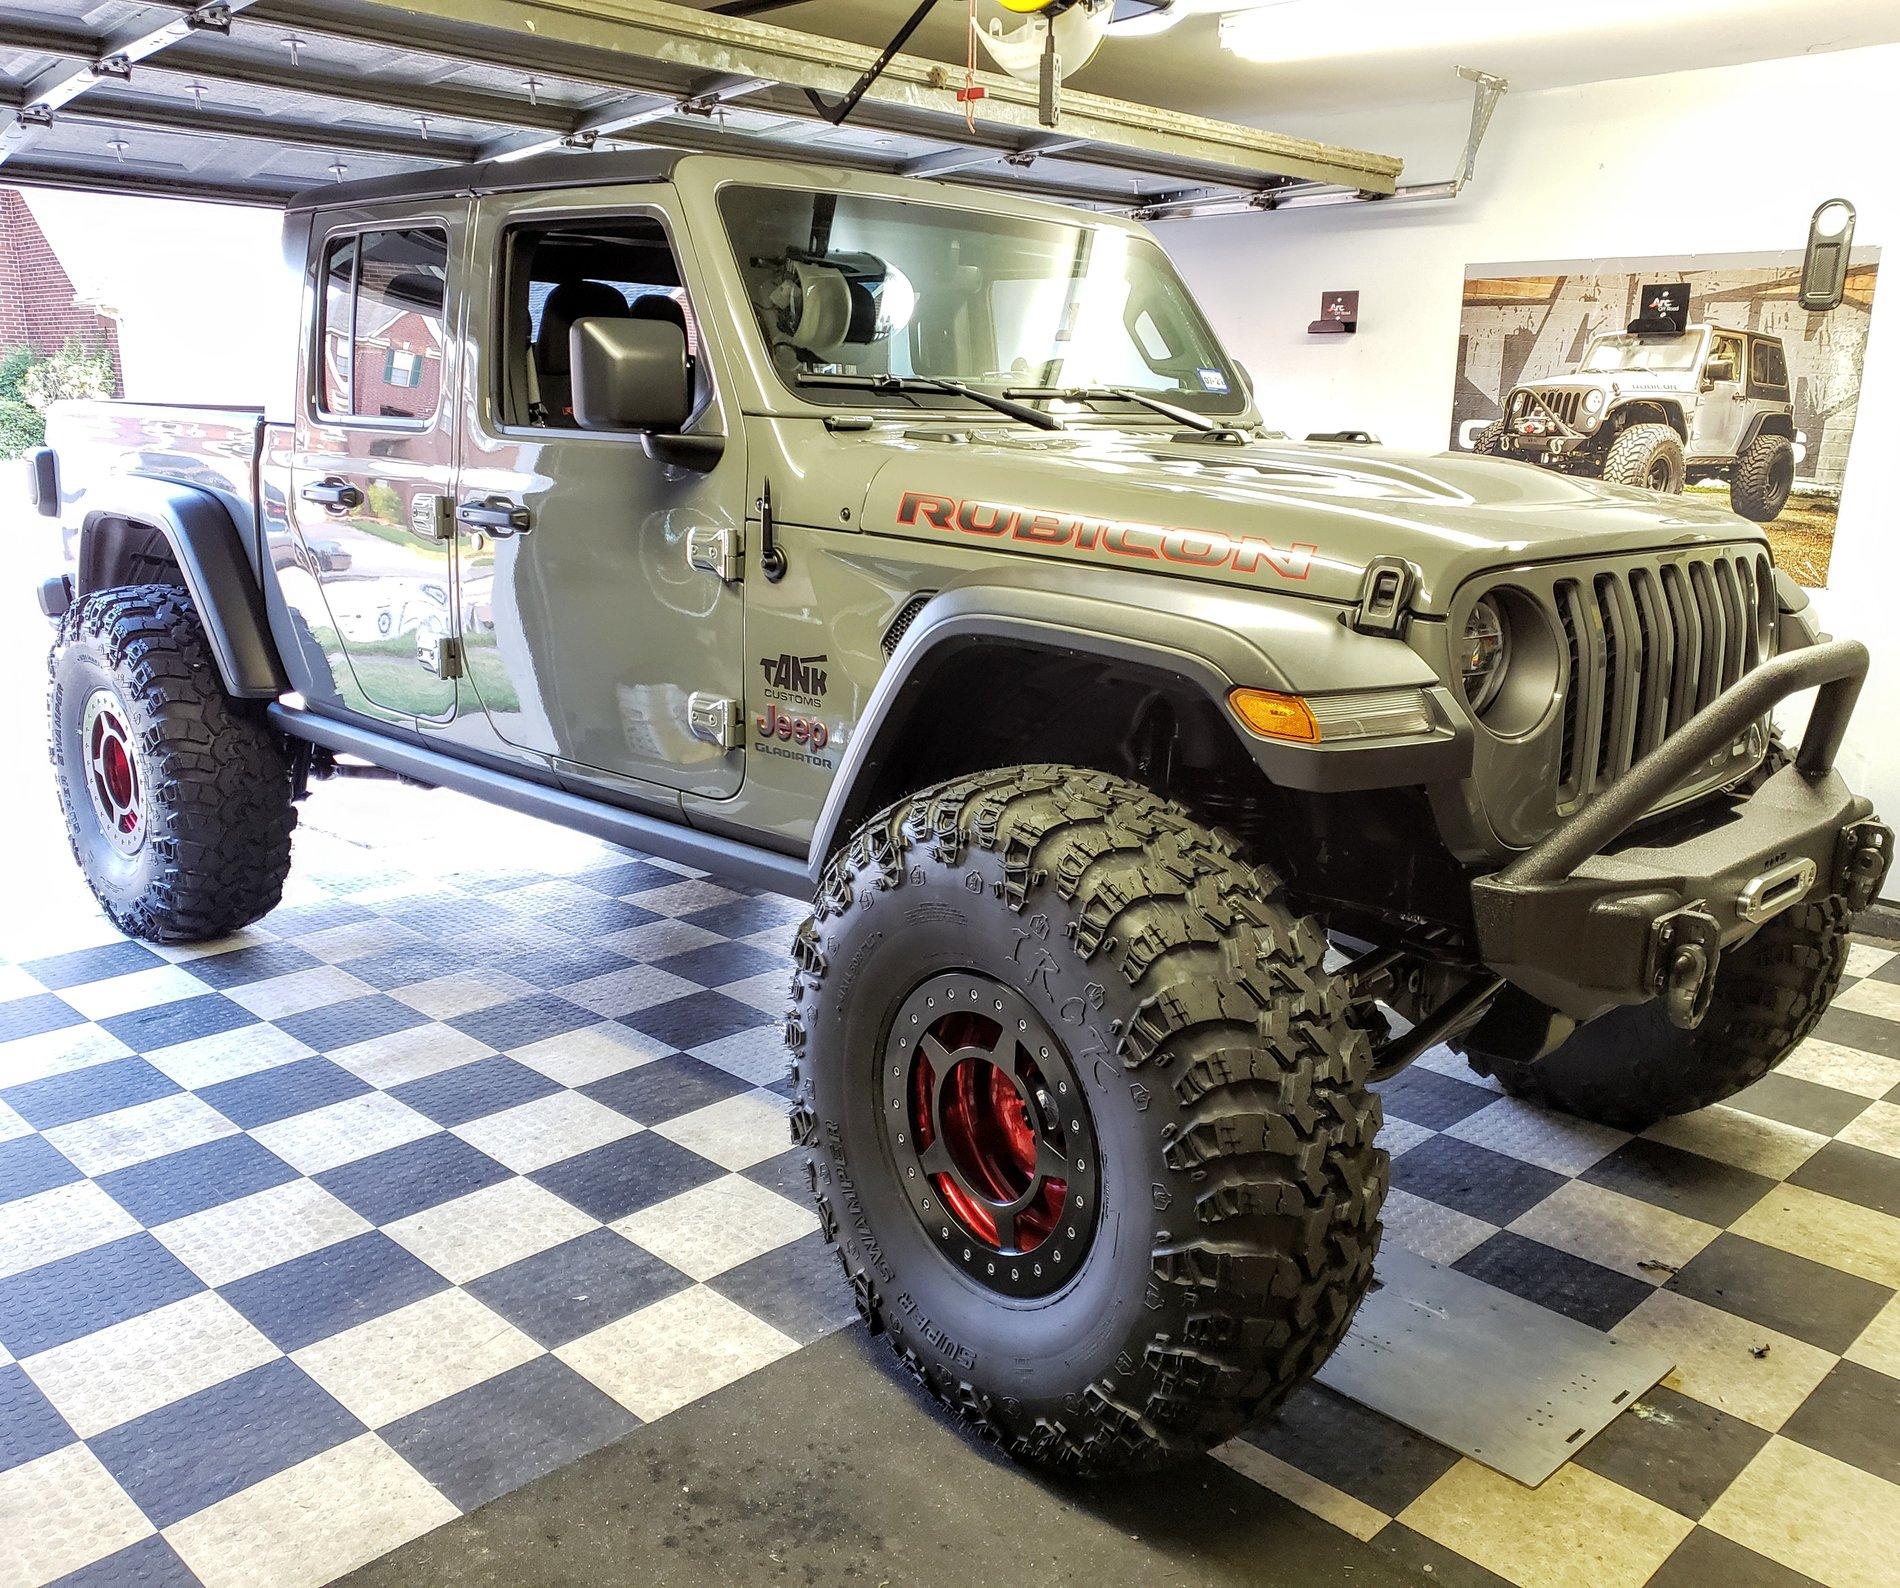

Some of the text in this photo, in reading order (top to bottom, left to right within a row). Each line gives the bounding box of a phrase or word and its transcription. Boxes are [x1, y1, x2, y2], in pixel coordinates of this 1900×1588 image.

[1649, 297, 1672, 308] Arc
[897, 491, 1319, 580] RUBICON
[760, 653, 828, 696] TANK
[764, 688, 822, 708] CUSTOMS
[756, 703, 828, 754] Jeep
[754, 742, 833, 770] GLADIATOR
[825, 1119, 977, 1370] SUPER SWAMPER
